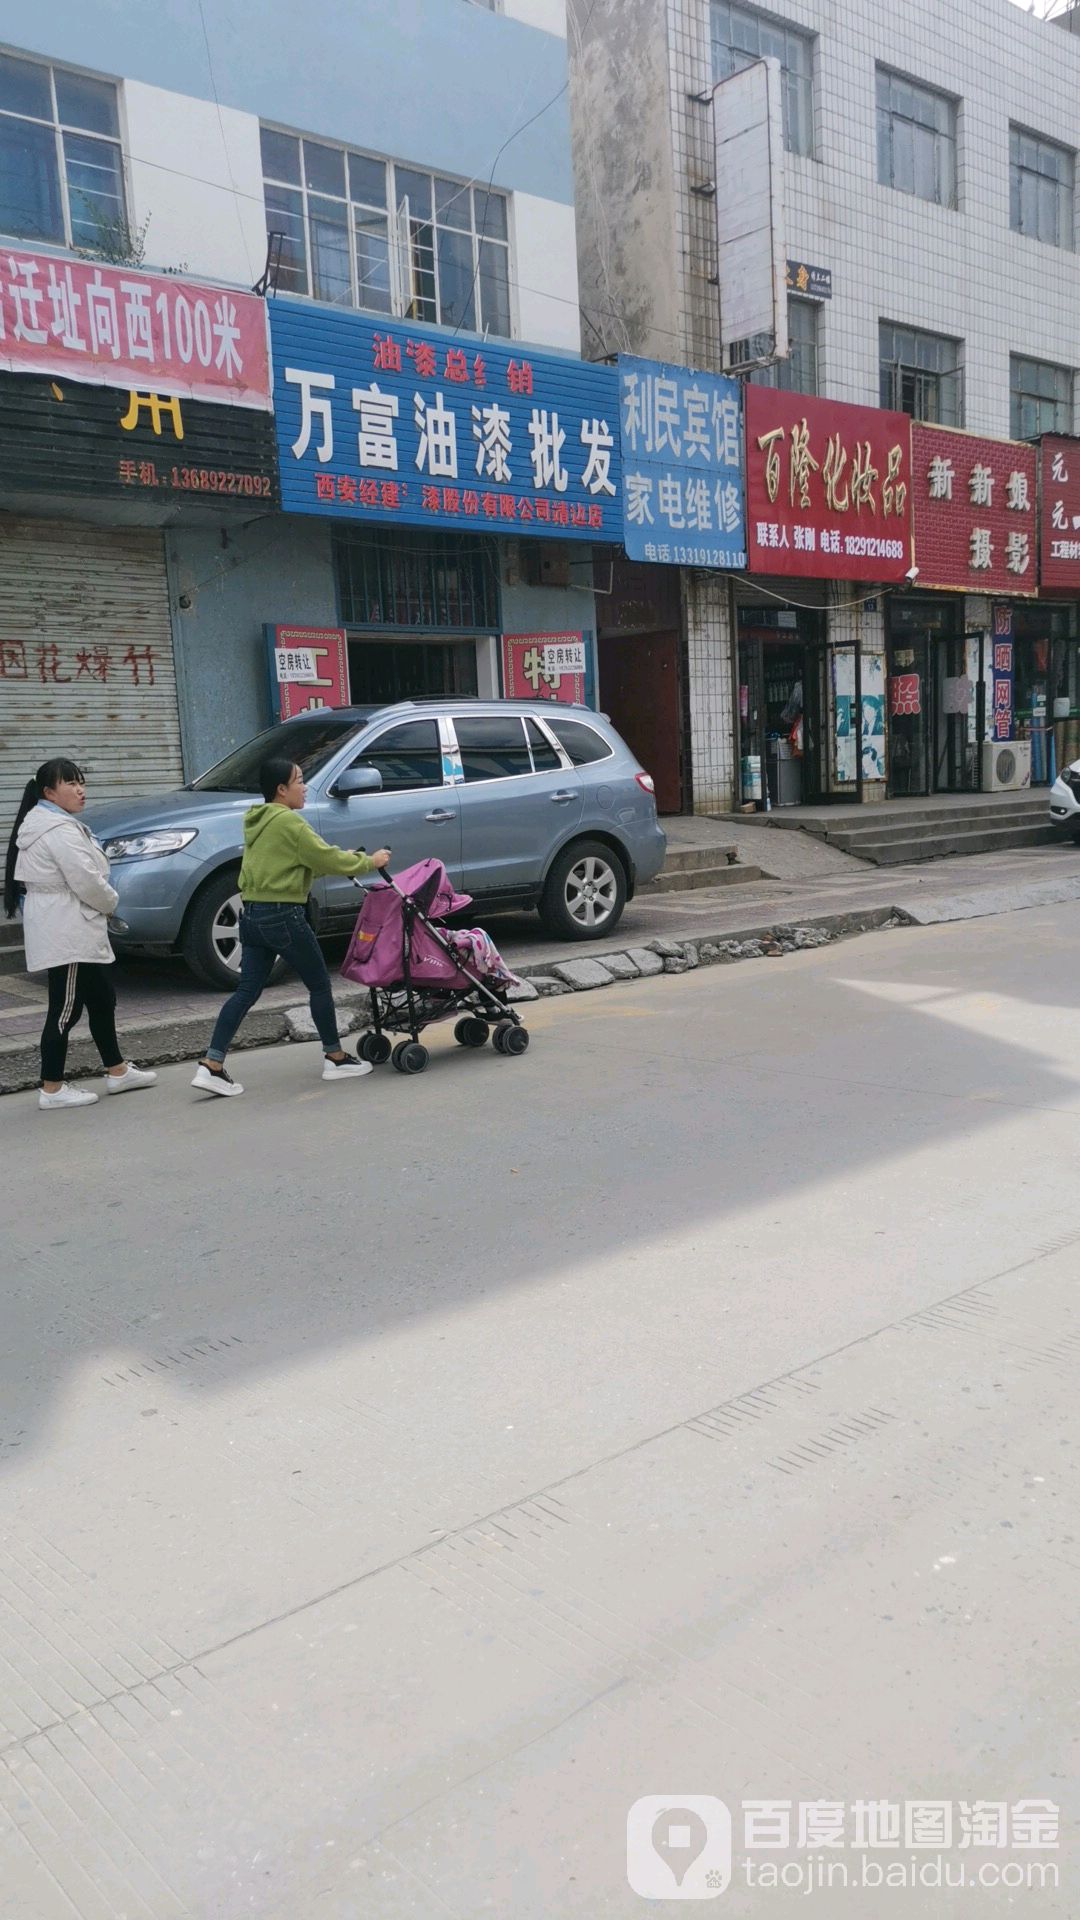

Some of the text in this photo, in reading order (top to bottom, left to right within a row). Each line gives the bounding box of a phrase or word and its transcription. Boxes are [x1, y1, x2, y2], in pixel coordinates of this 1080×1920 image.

[0, 255, 243, 379] 迁址向西100米
[285, 367, 617, 497] 万富油漆批发
[623, 373, 739, 467] 利民宾馆
[758, 417, 906, 519] 百隆化妆品
[625, 471, 741, 533] 家电维修
[1051, 500, 1080, 531] 元
[757, 522, 790, 549] 联系人
[969, 527, 1030, 575] 摄影
[1050, 540, 1080, 560] 工程材
[279, 653, 312, 670] 空房转让
[548, 647, 582, 664] 空房转让
